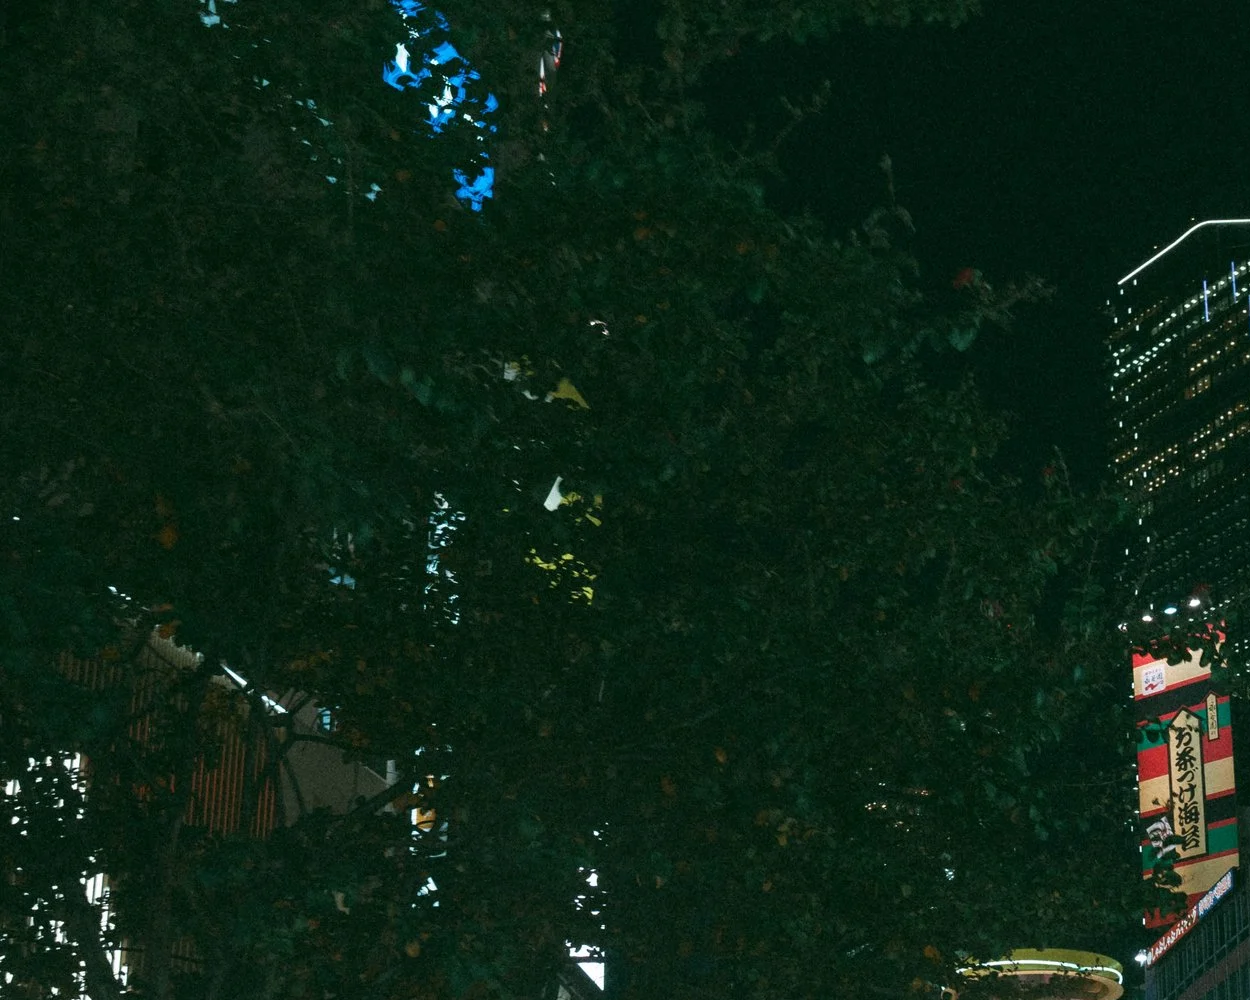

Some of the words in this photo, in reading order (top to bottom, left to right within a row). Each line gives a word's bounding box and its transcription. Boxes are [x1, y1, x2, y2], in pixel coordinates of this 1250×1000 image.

[1174, 724, 1201, 852] お茶づけ海苔
